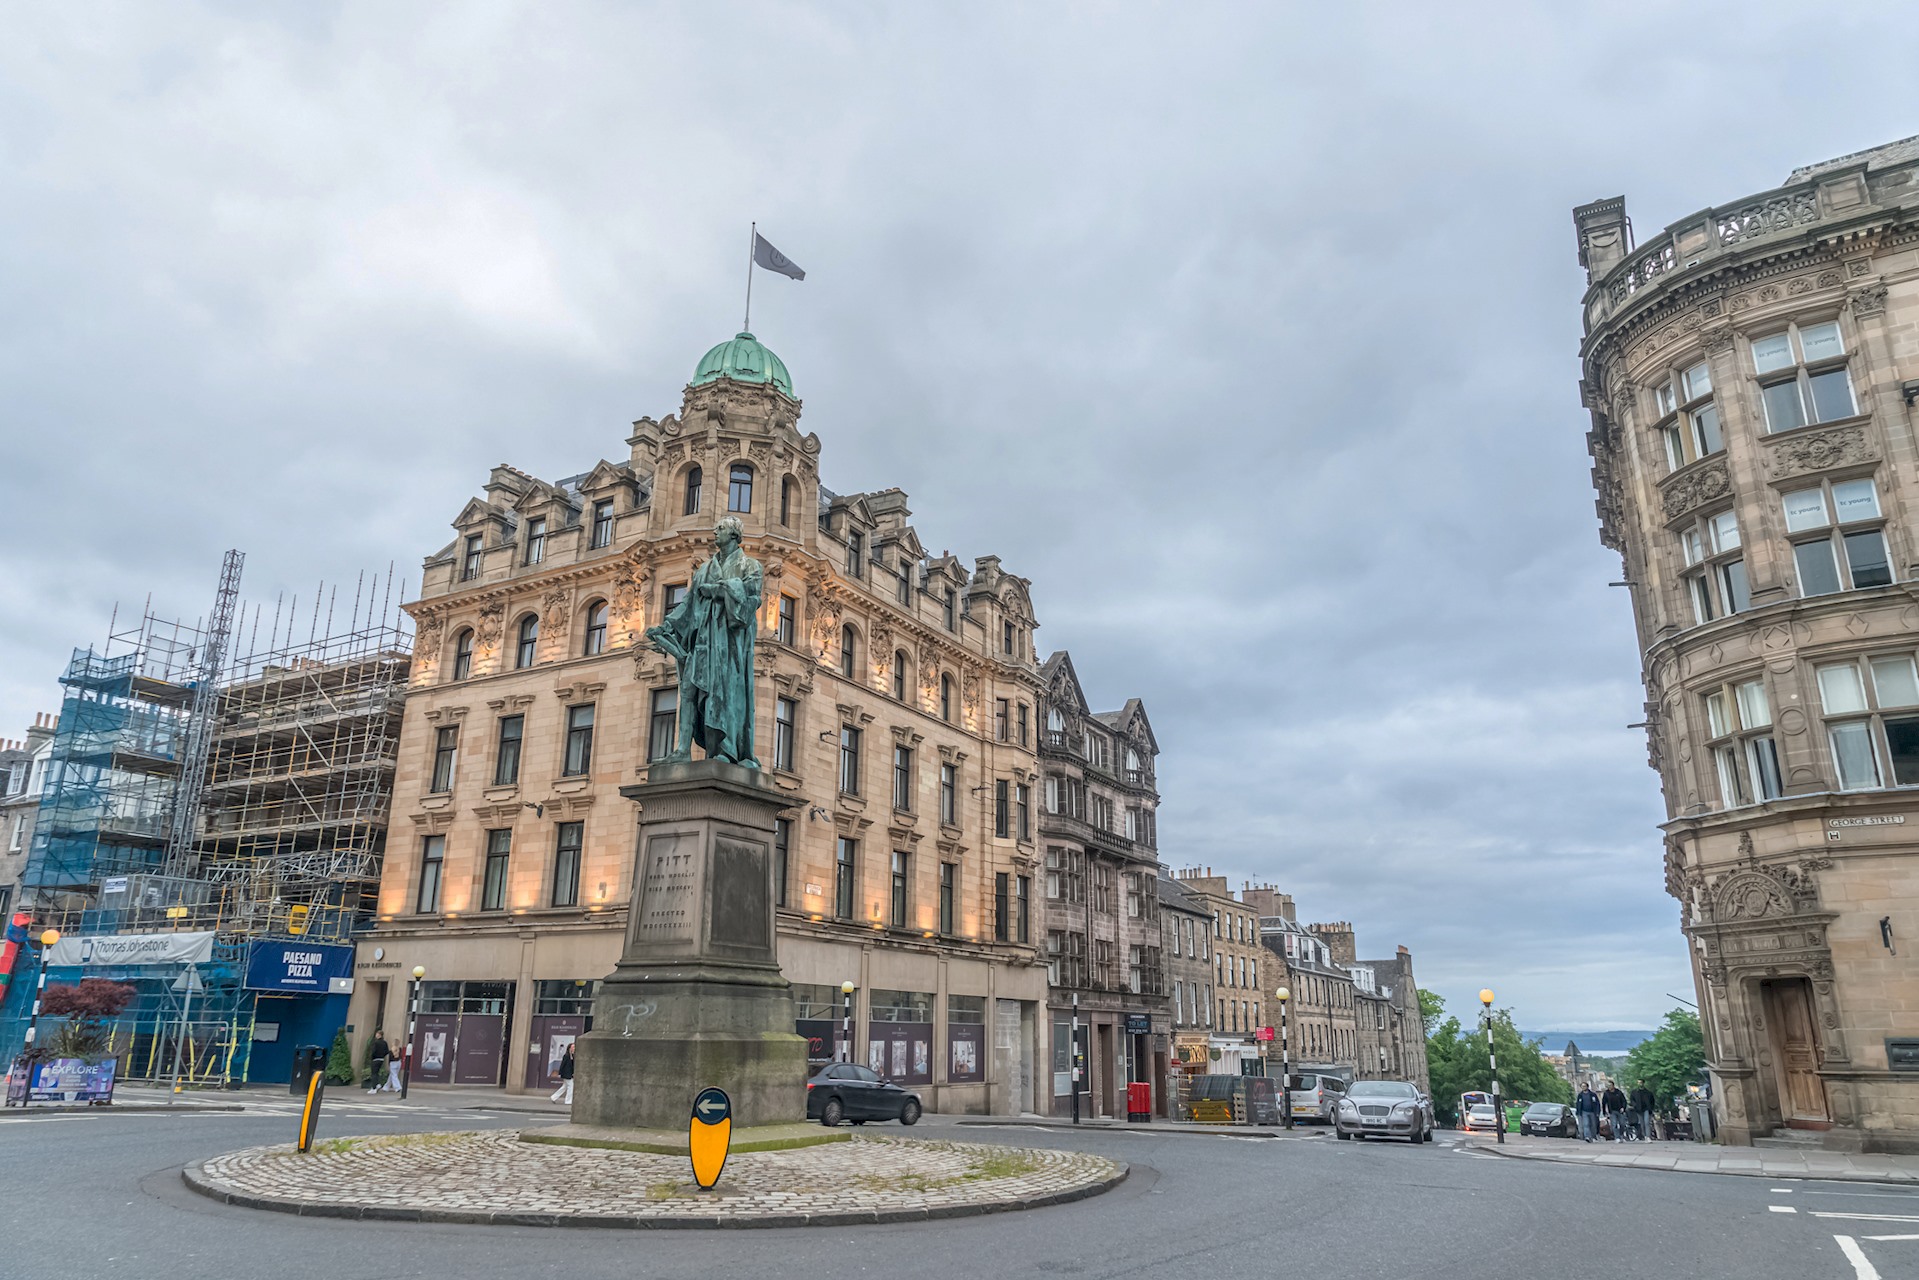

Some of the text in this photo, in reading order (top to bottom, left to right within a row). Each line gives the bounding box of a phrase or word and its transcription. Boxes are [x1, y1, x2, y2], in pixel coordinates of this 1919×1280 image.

[1870, 816, 1902, 824] STREET
[657, 854, 691, 866] PITT
[95, 941, 126, 953] Thomas
[282, 951, 322, 965] PAESANO
[287, 964, 313, 977] PIZZA
[51, 1065, 99, 1074] EXPLORE
